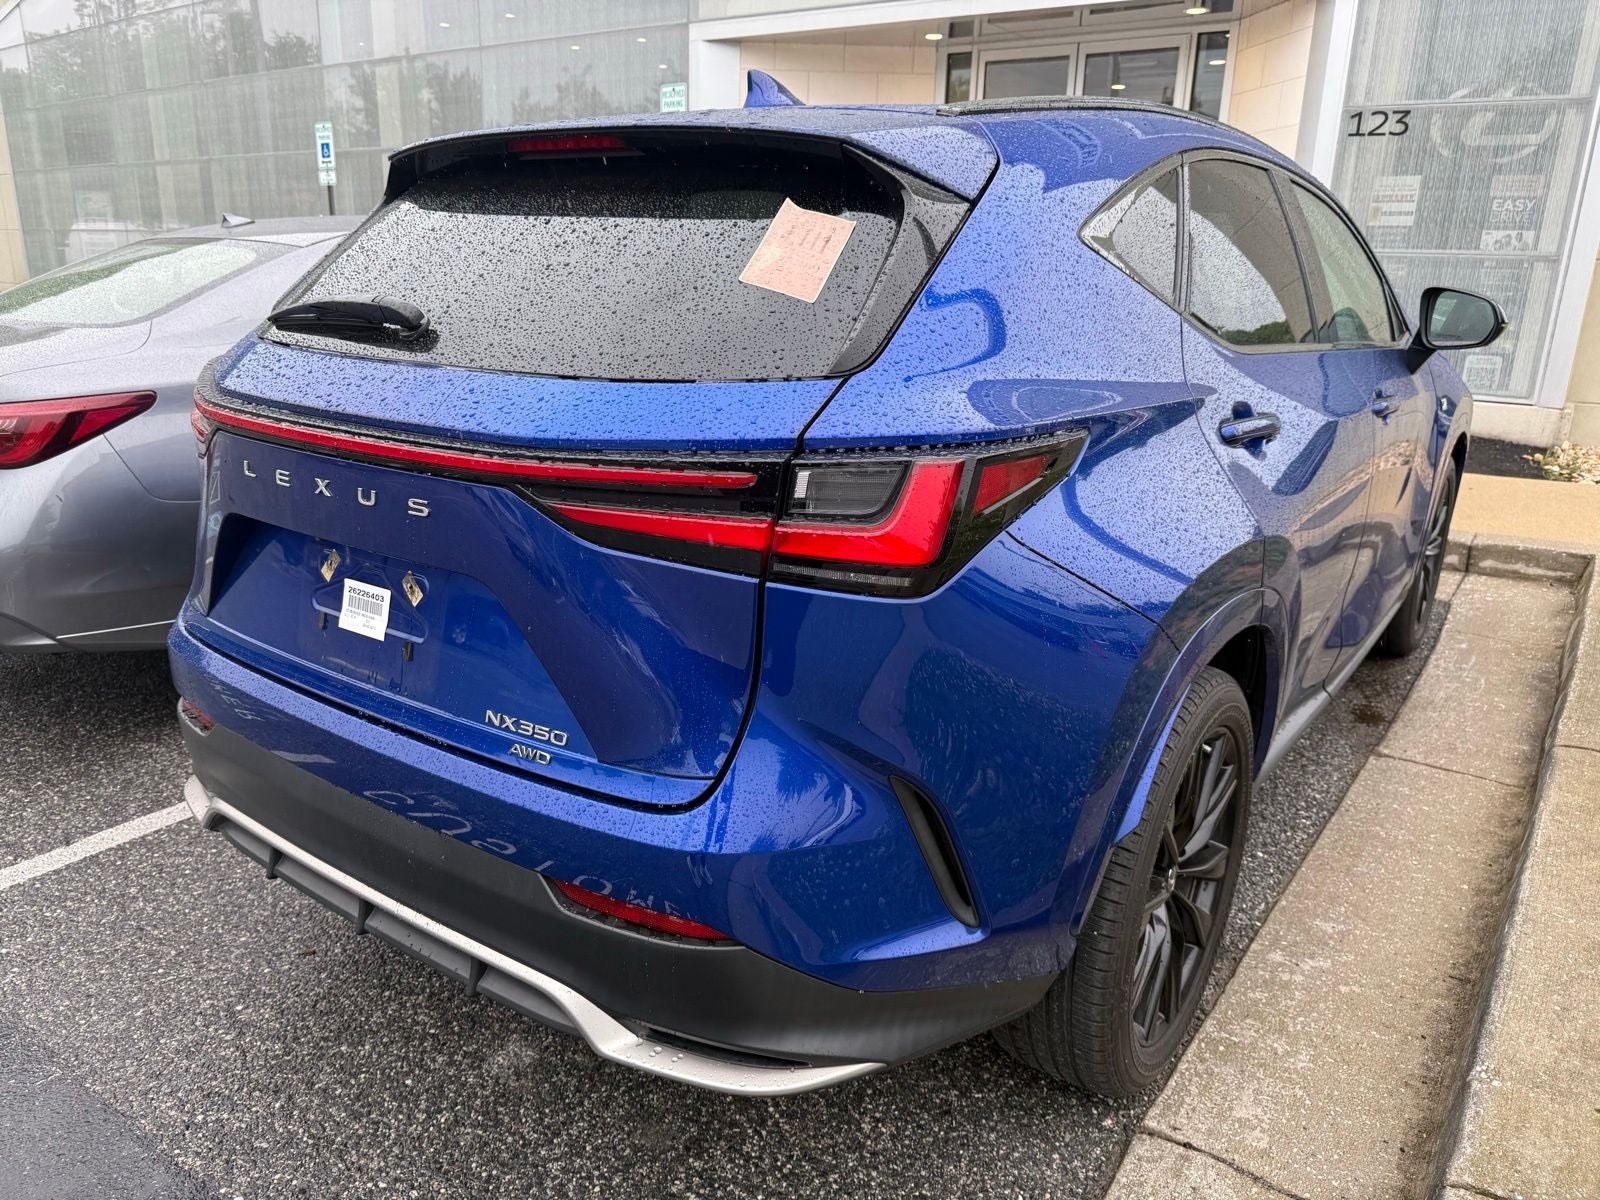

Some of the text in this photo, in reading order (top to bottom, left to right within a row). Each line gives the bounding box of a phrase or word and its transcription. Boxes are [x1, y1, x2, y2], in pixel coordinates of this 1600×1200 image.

[1347, 110, 1412, 137] 123
[1492, 199, 1536, 211] EASY
[243, 460, 431, 517] LEXUS
[348, 586, 385, 603] 26226403
[485, 709, 569, 747] NX350
[508, 743, 551, 765] AWD
